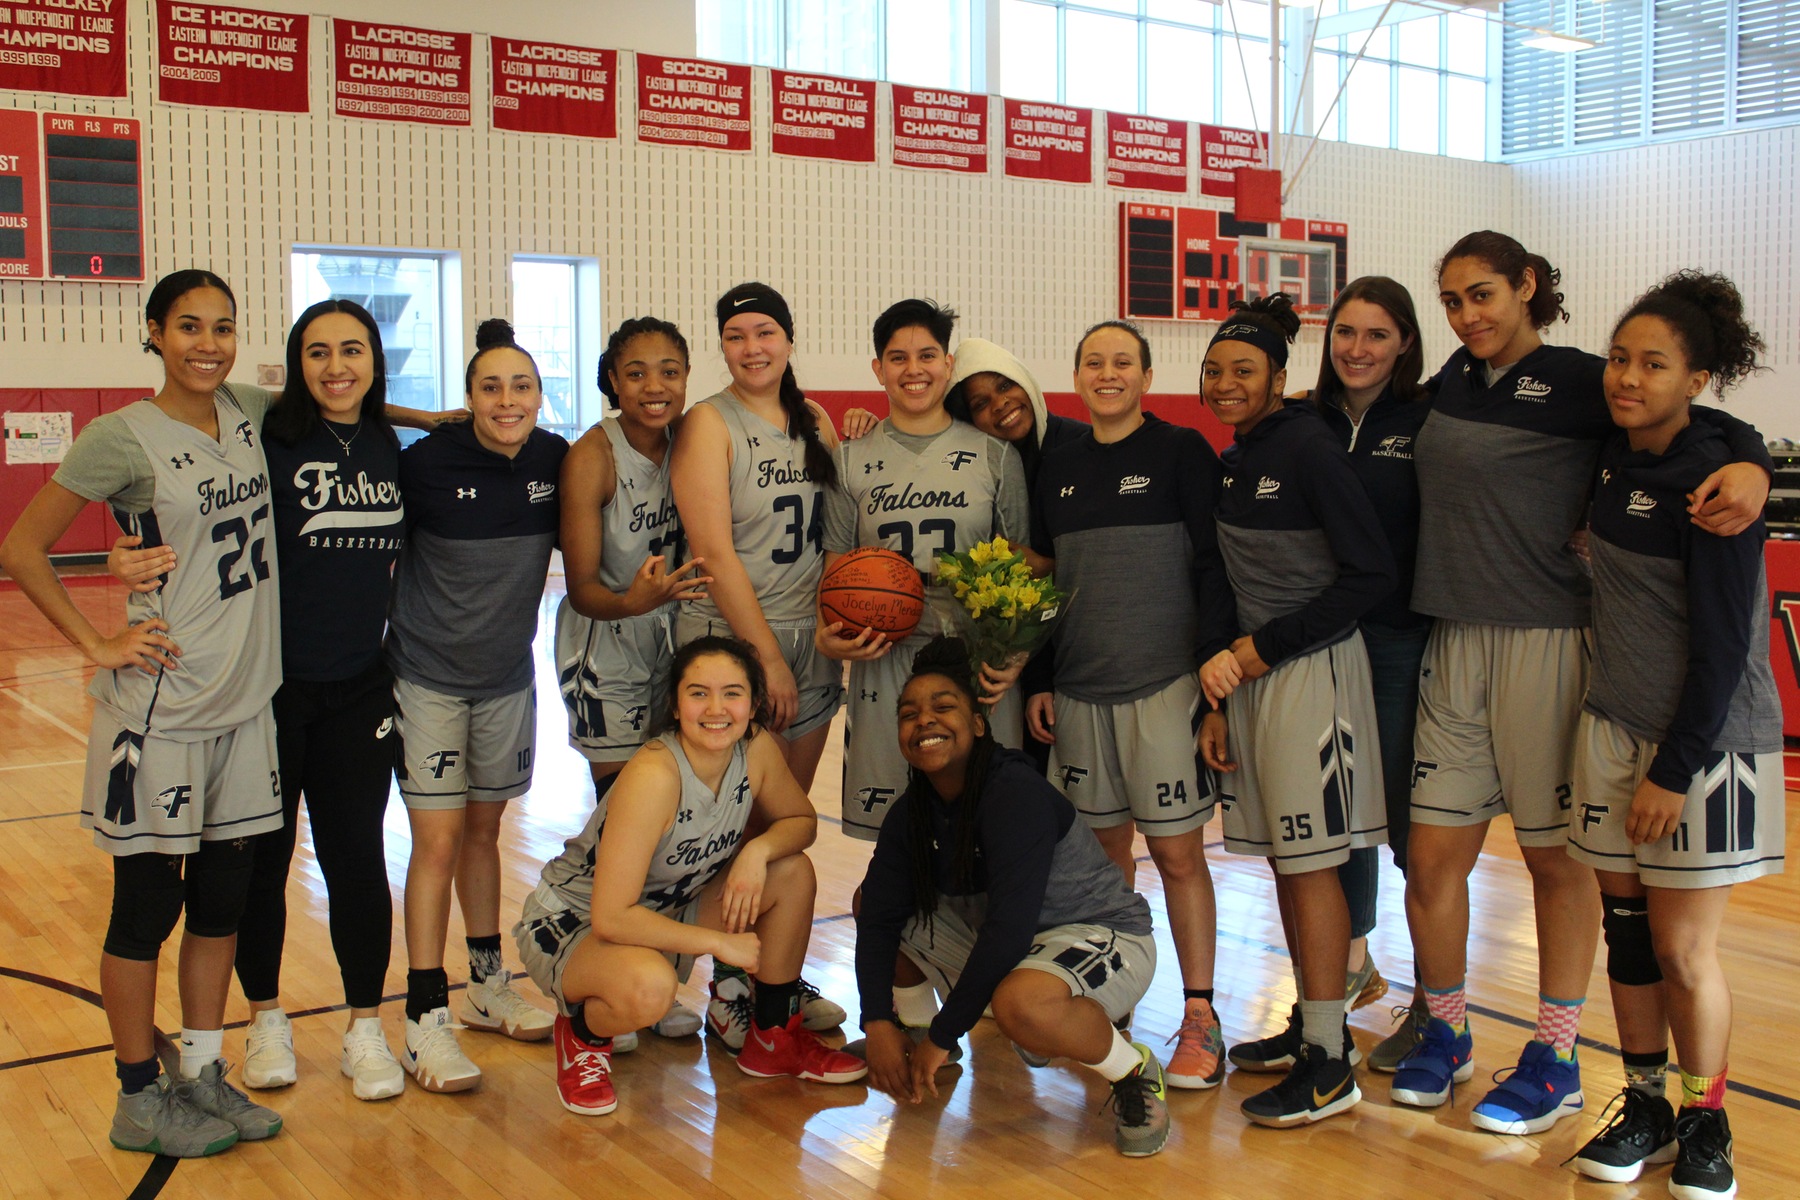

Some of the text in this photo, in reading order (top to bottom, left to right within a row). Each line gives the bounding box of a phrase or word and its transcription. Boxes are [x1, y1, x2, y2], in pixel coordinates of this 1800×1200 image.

[16, 9, 75, 30] INDEPENDENT
[80, 15, 115, 34] LEAGUE
[171, 5, 294, 33] ICE HOCKEY
[169, 26, 298, 53] EASTERN INDEPENDENT LEAGUE
[351, 25, 455, 50] LACROSSE
[31, 54, 59, 66] 1996
[173, 46, 294, 72] CHAMPIONS
[345, 43, 462, 70] EASTERN INDEPENDENT LEAGUE
[507, 43, 602, 66] LACROSSE
[162, 66, 219, 82] 2004 2005
[349, 62, 458, 88] CHAMPIONS
[501, 60, 608, 84] EASTERN INDEPENDENT LEAGUE
[662, 60, 728, 81] SOCCER
[338, 81, 469, 104] 1991 1993 1994 1995 1996
[505, 79, 605, 102] CHAMPIONS
[646, 75, 744, 100] EASTERN INDEPENDENT LEAGUE
[783, 75, 864, 97] SOFTBALL
[338, 99, 468, 121] 1997 1998 1999 2000 2001
[495, 96, 518, 109] 2002
[648, 94, 740, 116] CHAMPIONS
[779, 91, 806, 106] EASTERN
[846, 99, 869, 113] LEAGUE
[913, 90, 969, 109] SQUASH
[782, 108, 866, 129] CHAMPIONS
[1020, 104, 1077, 122] SWIMMING
[52, 118, 130, 135] PLYR FLS PTS
[902, 121, 979, 141] CHAMPIONS
[1127, 118, 1168, 134] TENNIS
[1219, 129, 1254, 145] TRACK
[1013, 134, 1084, 152] CHAMPIONS
[1115, 145, 1180, 164] CHAMPIONS
[1186, 238, 1210, 251] HOME
[90, 255, 102, 275] 0
[1182, 278, 1201, 288] FOULS
[1182, 310, 1200, 319] SCORE
[1517, 376, 1551, 391] Fisher
[1372, 451, 1413, 459] BASKETBALL
[294, 461, 401, 511] Fisher
[527, 480, 554, 494] Fisher
[867, 483, 969, 516] Falcons
[772, 491, 823, 565] 34
[211, 503, 269, 601] 22
[842, 593, 886, 617] Jocelyn
[517, 747, 530, 773] 10
[1156, 780, 1187, 808] 24
[1280, 813, 1313, 842] 35
